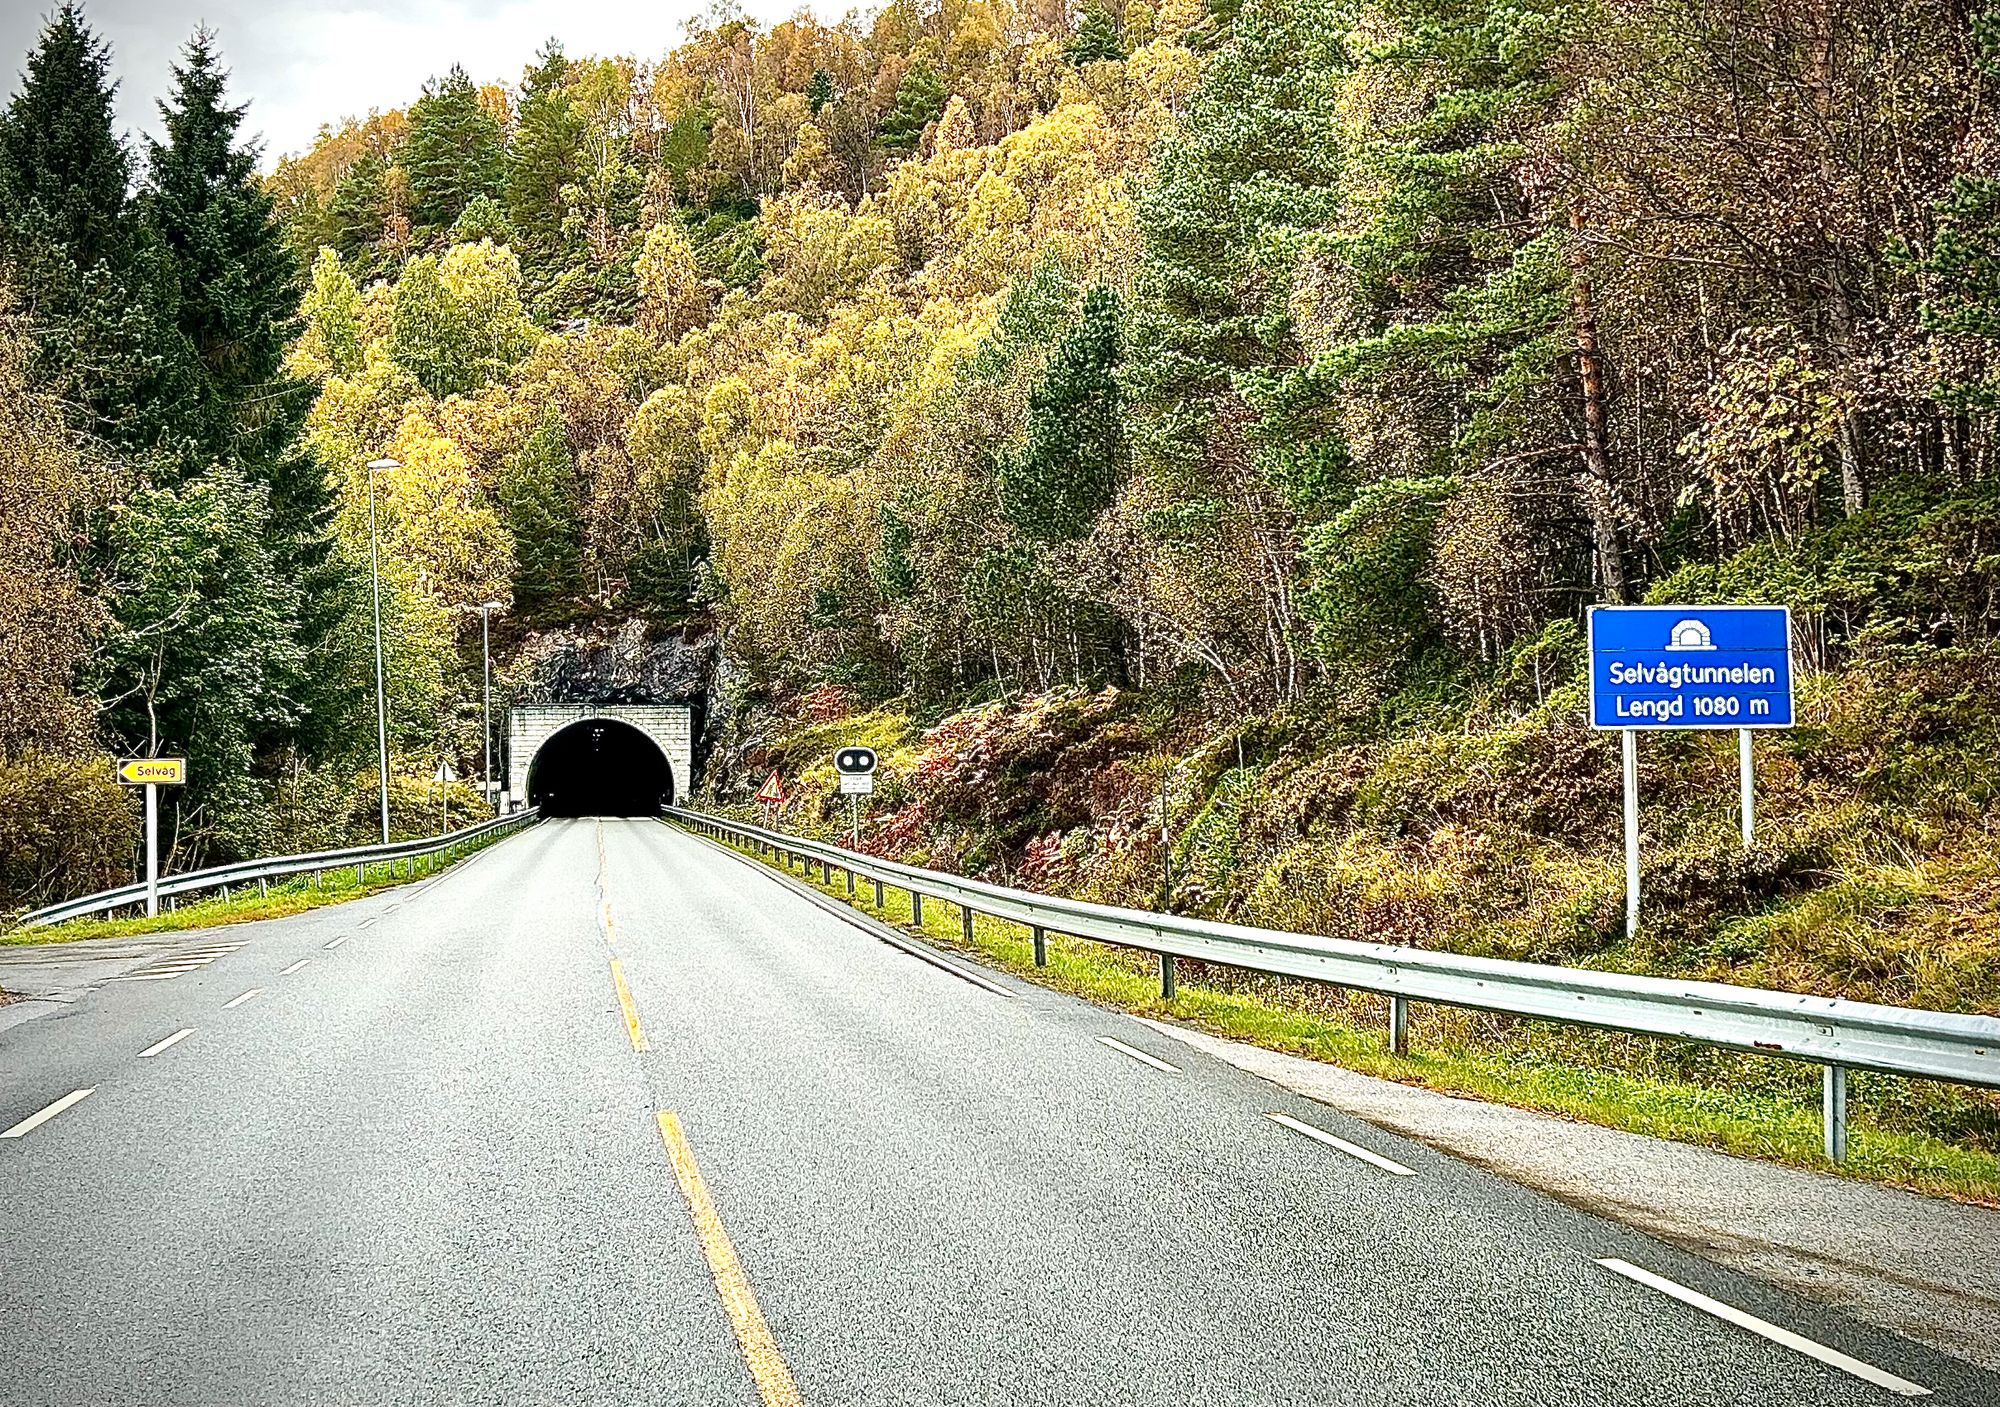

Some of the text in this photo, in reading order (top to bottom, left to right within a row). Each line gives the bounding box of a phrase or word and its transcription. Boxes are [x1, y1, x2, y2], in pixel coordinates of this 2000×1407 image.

[1609, 661, 1775, 689] Selvågtunnelen
[1616, 694, 1769, 722] Lengd 1080 m
